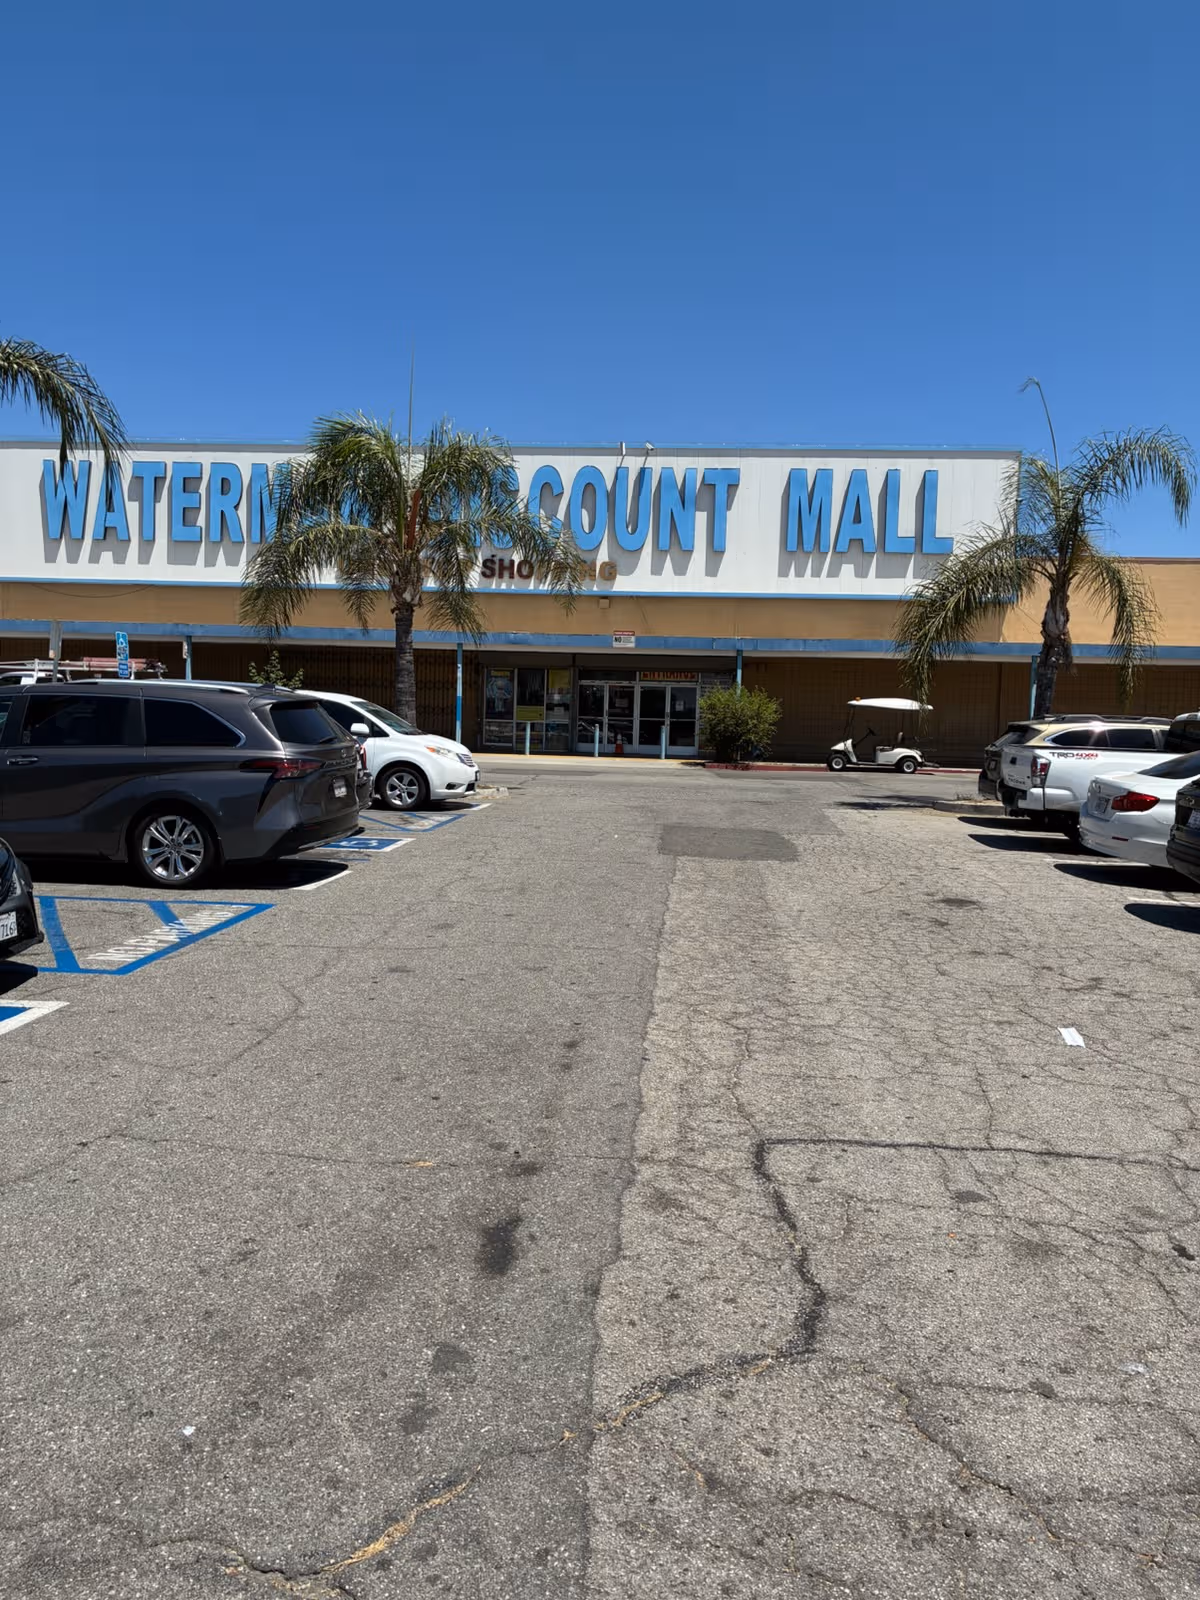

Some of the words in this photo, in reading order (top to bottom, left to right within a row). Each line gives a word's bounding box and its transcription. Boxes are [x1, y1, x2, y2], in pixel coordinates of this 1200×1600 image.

[42, 459, 377, 546] WATERM
[785, 468, 954, 555] MALL
[480, 558, 618, 582] SHONG
